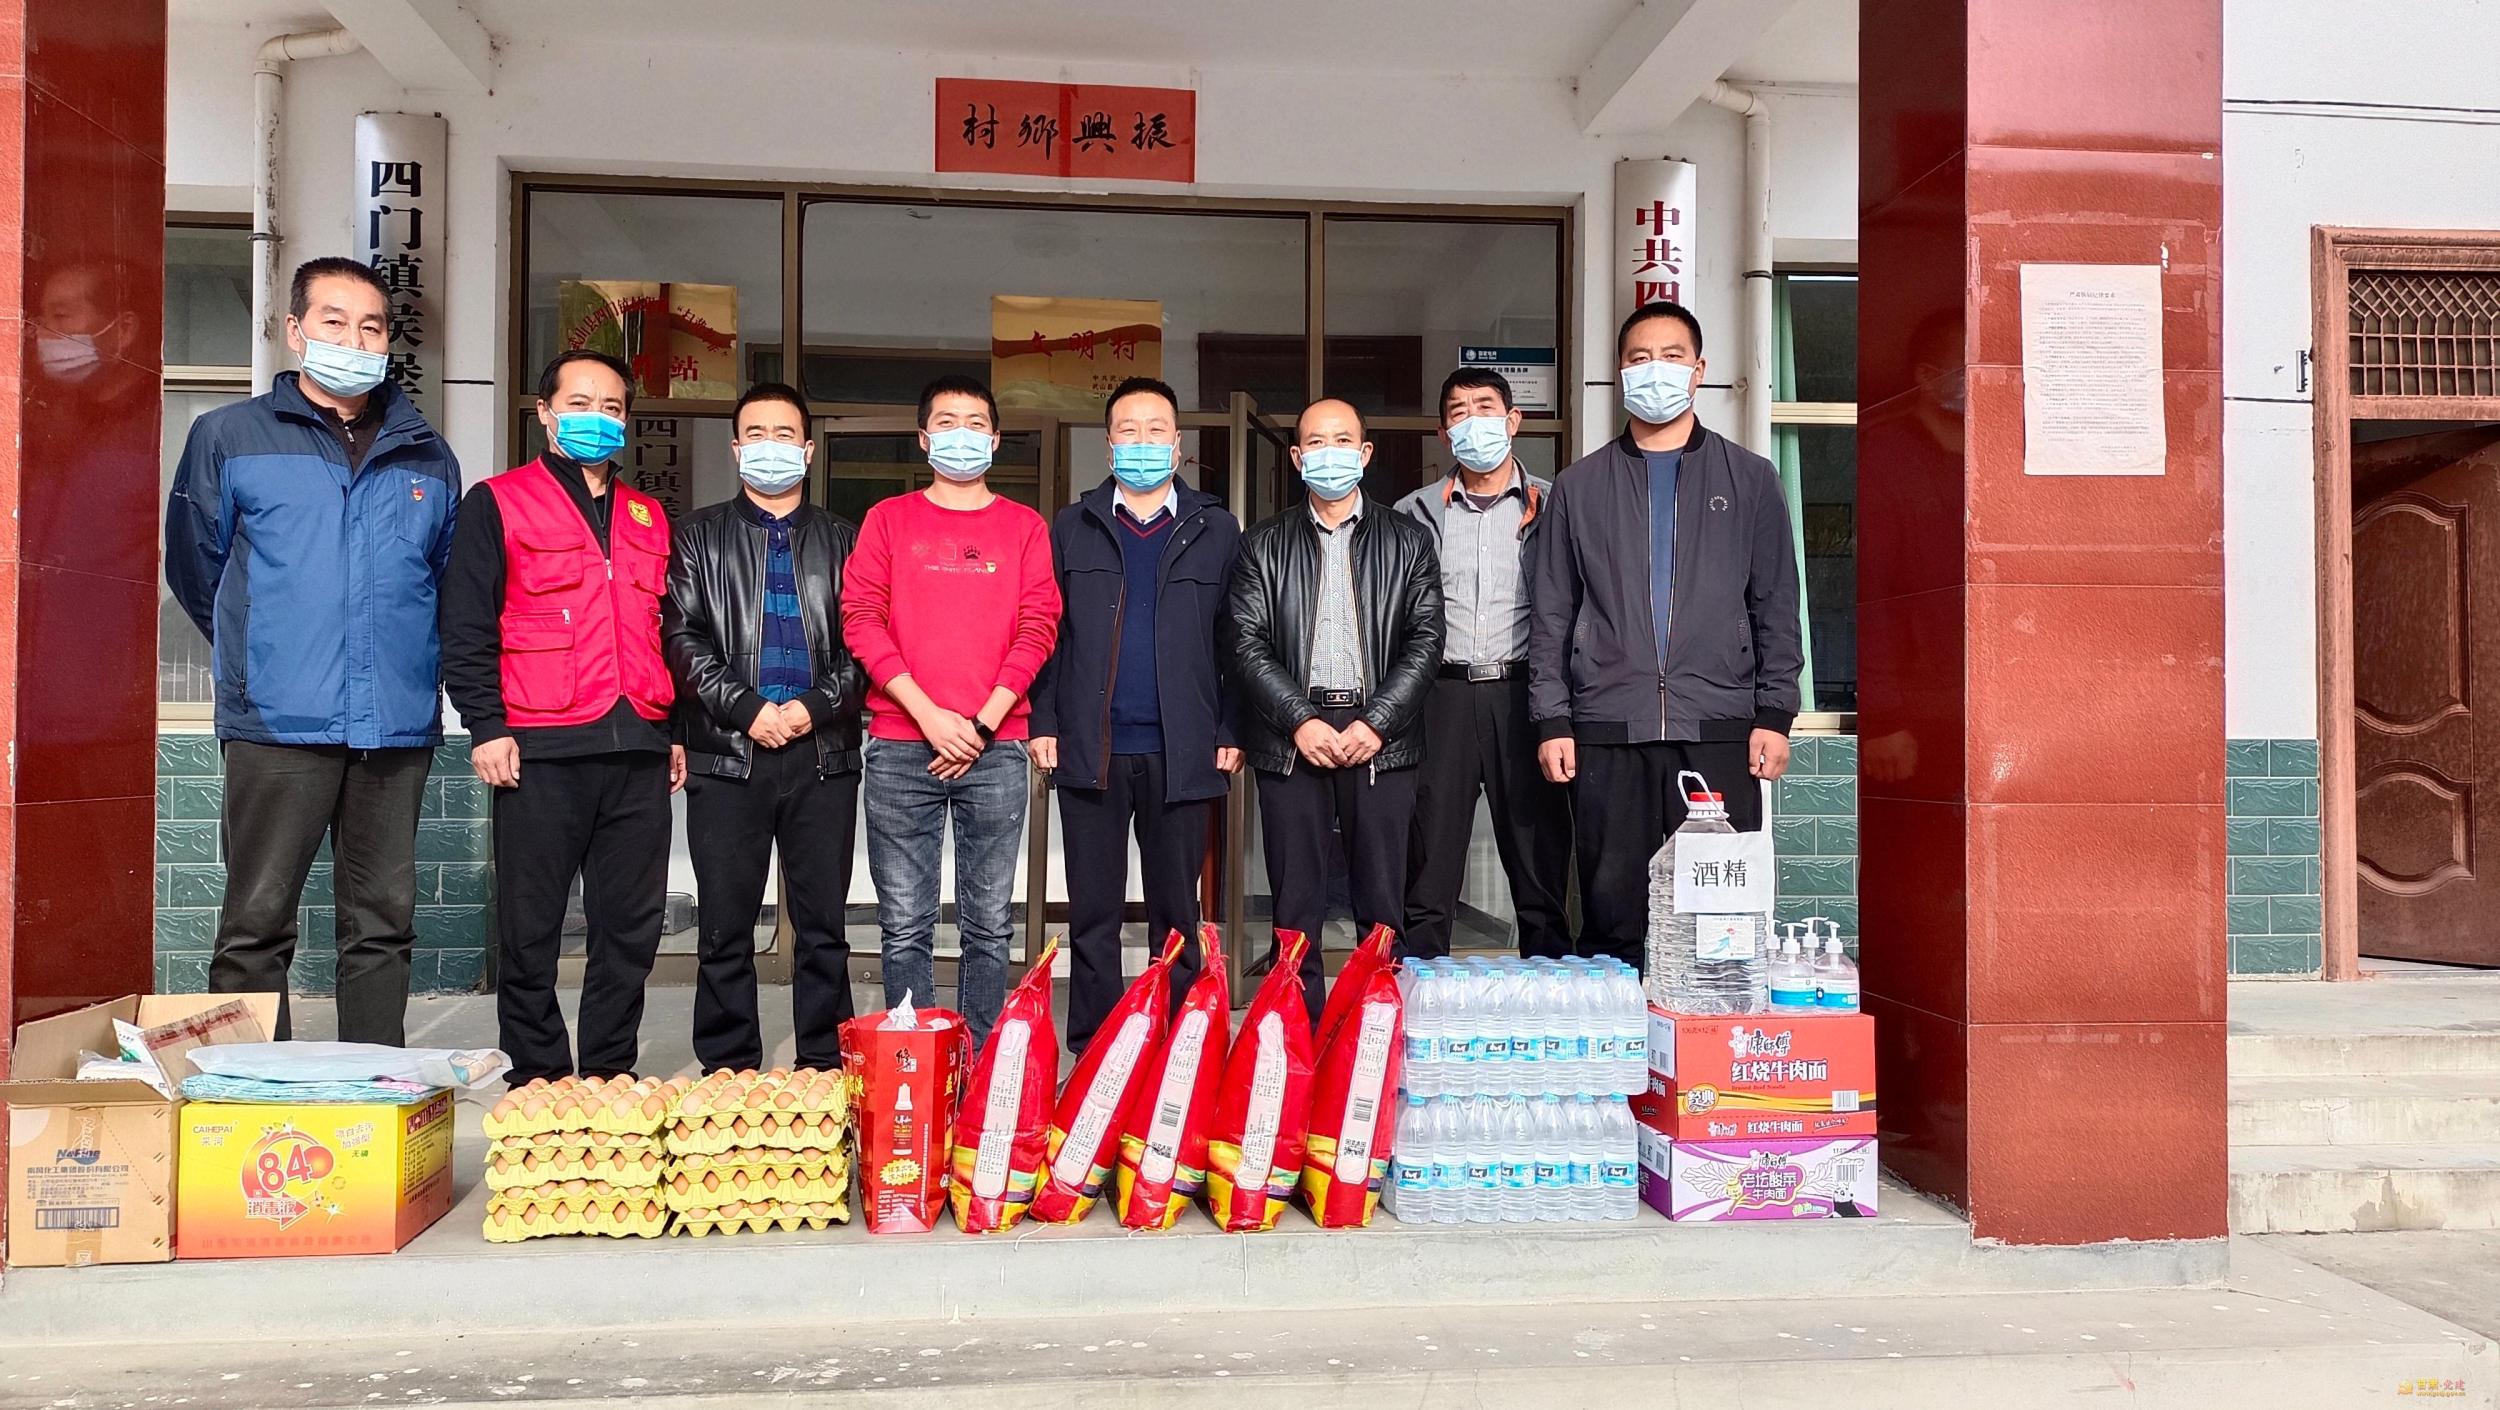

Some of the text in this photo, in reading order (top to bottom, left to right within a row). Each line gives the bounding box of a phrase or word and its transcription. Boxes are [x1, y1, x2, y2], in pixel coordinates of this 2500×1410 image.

[1632, 200, 1683, 309] 中共四
[1692, 859, 1748, 888] 酒精
[1731, 1059, 1828, 1083] 红烧牛肉面
[1747, 1120, 1803, 1134] 红烧牛肉面
[258, 1143, 313, 1192] 84
[1741, 1172, 1798, 1188] 老坛酸菜
[1752, 1188, 1787, 1201] 牛肉面
[248, 1200, 297, 1216] 消毒液
